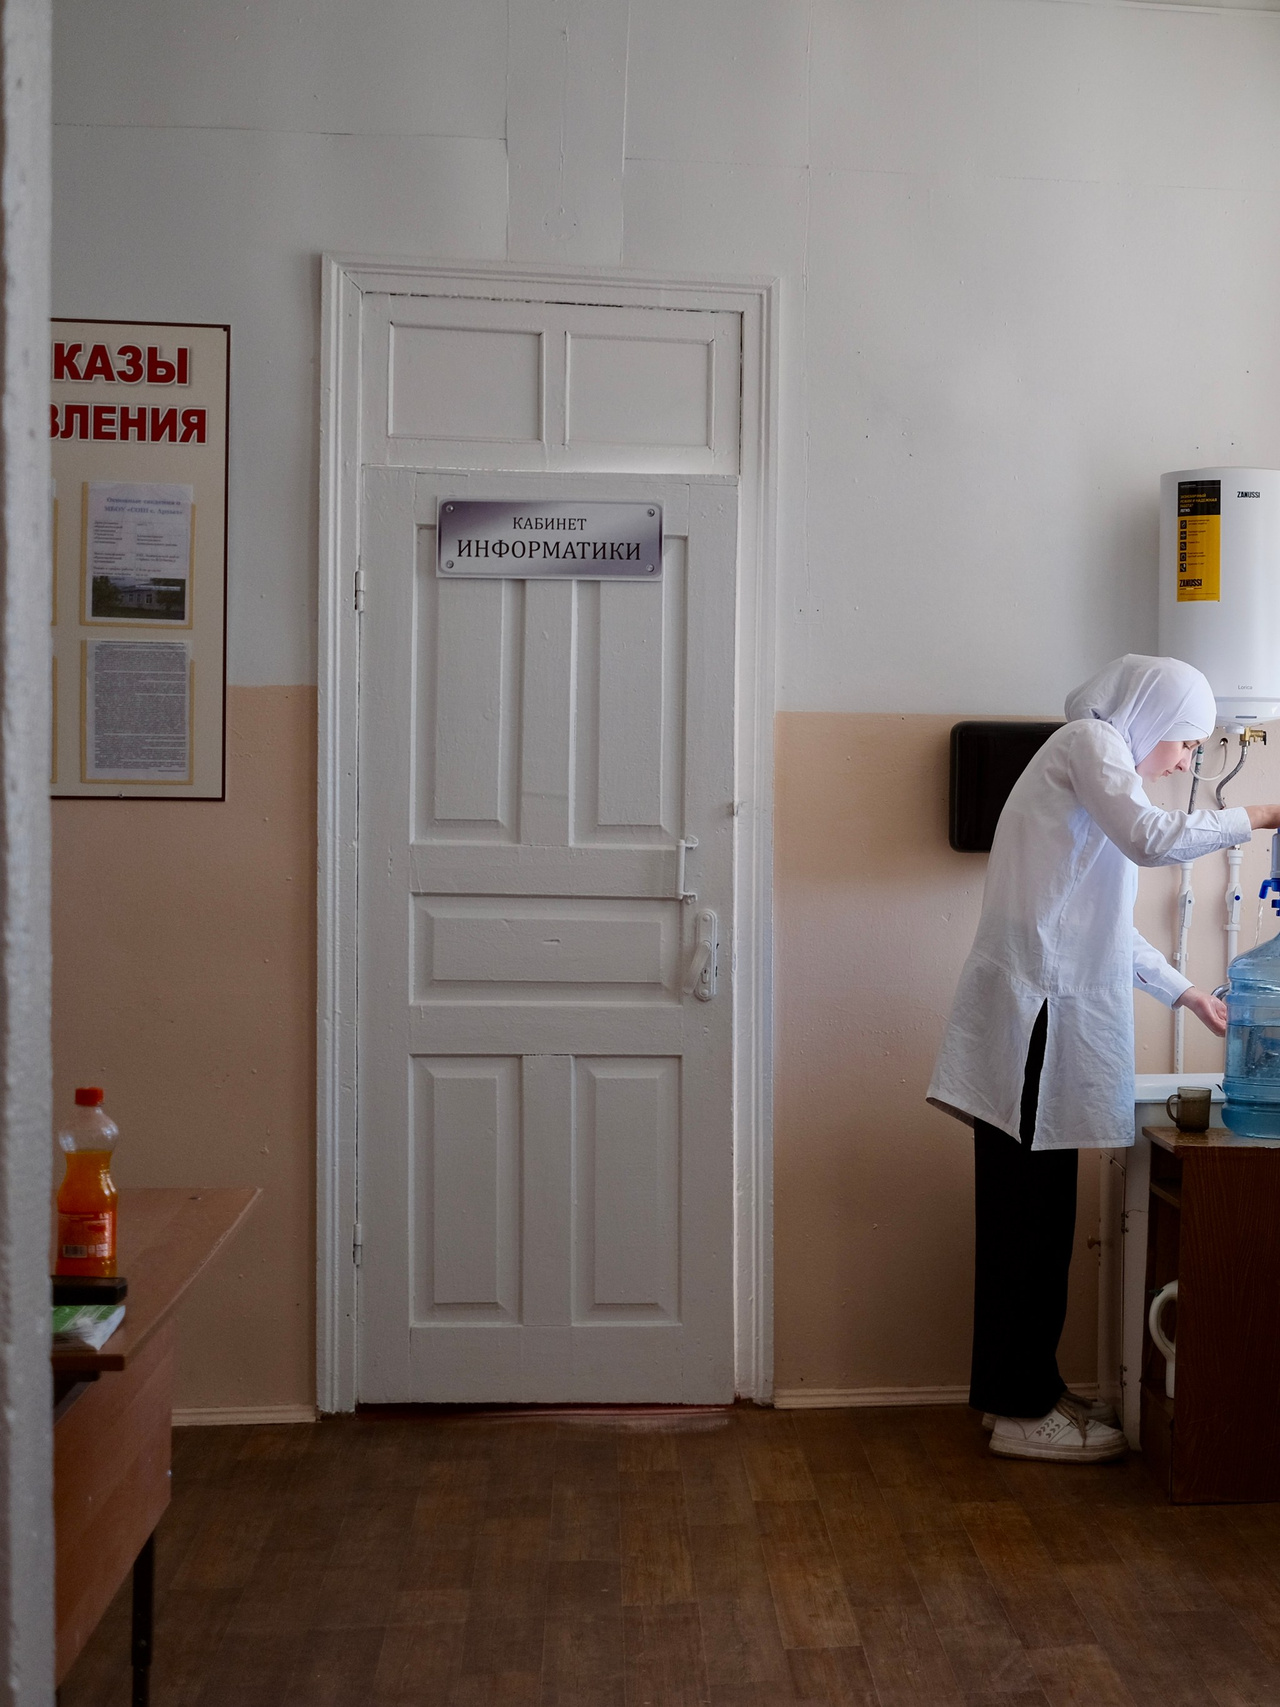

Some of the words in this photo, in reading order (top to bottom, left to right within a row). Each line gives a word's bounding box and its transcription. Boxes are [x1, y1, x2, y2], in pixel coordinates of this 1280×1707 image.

[53, 342, 189, 385] КАЗЫ
[512, 517, 587, 531] КАБИНЕТ
[457, 539, 641, 560] ИНФОРМАТИКИ
